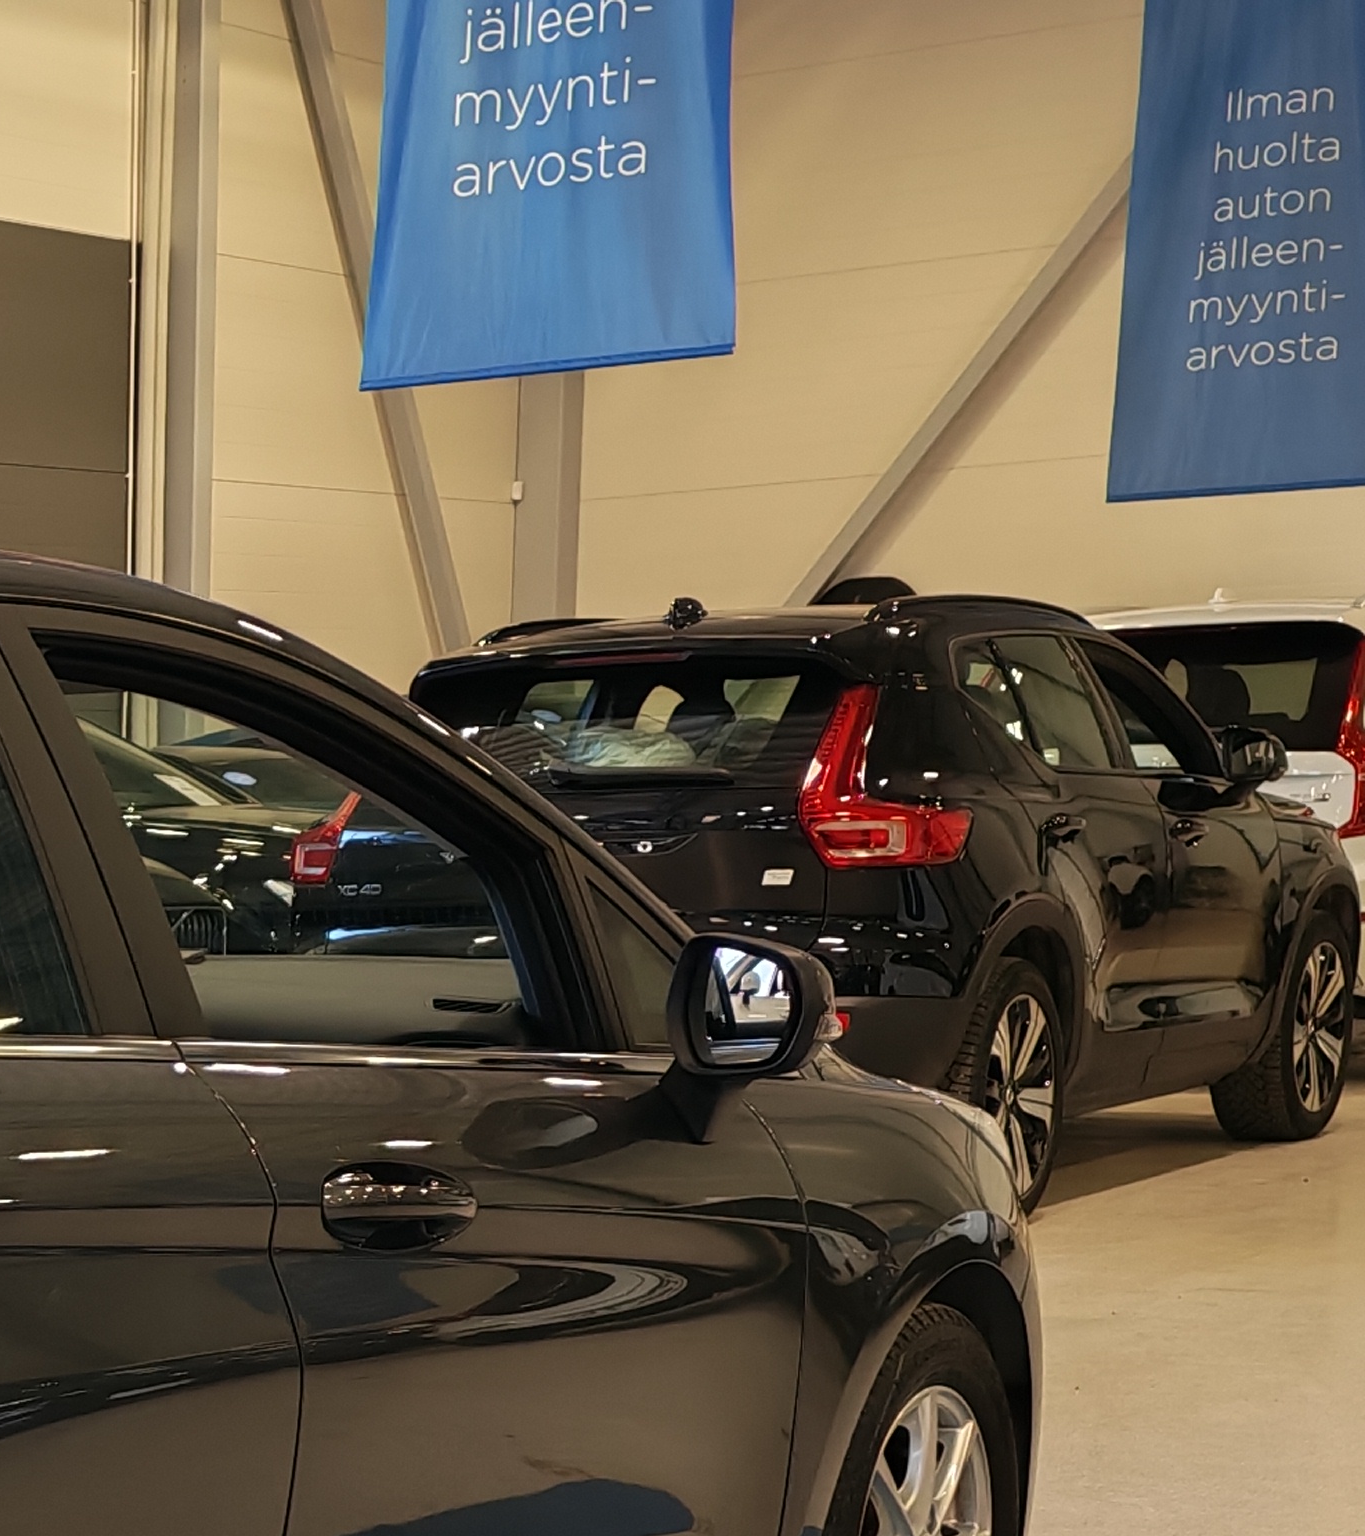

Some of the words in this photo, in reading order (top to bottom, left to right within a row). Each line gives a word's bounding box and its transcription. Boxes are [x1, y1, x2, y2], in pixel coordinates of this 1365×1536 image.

[459, 0, 653, 64] jälleen-
[454, 56, 656, 131] myynti-
[1226, 86, 1335, 123] Ilman
[453, 135, 646, 198] arvosta
[1213, 131, 1340, 174] huolta
[1213, 186, 1332, 223] auton
[1194, 235, 1343, 281] jälleen-
[1188, 279, 1346, 326] myynti-
[1185, 331, 1339, 372] arvosta
